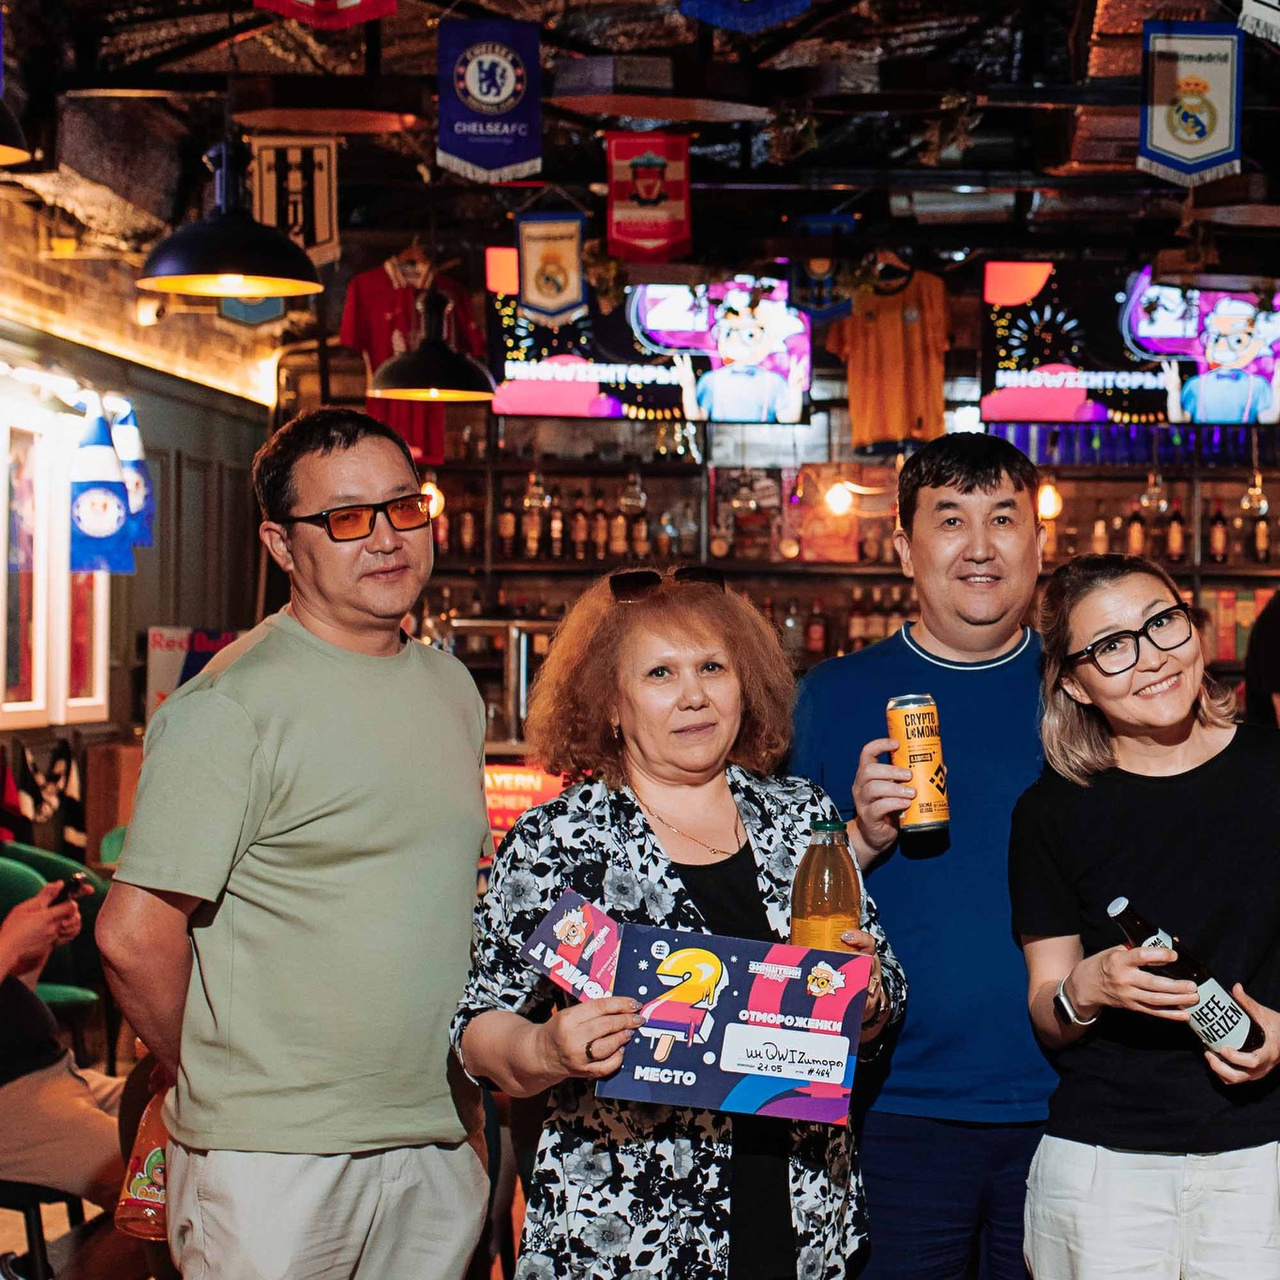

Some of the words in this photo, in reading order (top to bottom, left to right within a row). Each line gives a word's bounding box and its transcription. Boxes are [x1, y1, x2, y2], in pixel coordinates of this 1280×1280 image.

[904, 711, 936, 727] CRYPTO
[484, 772, 543, 792] AYERN
[738, 1008, 844, 1033] ОТМОРОЖЕНКИ
[1191, 994, 1226, 1028] HEFE
[1196, 1001, 1243, 1044] WEIZEN
[633, 1064, 698, 1087] МЕСТО
[757, 1062, 784, 1074] 21.05
